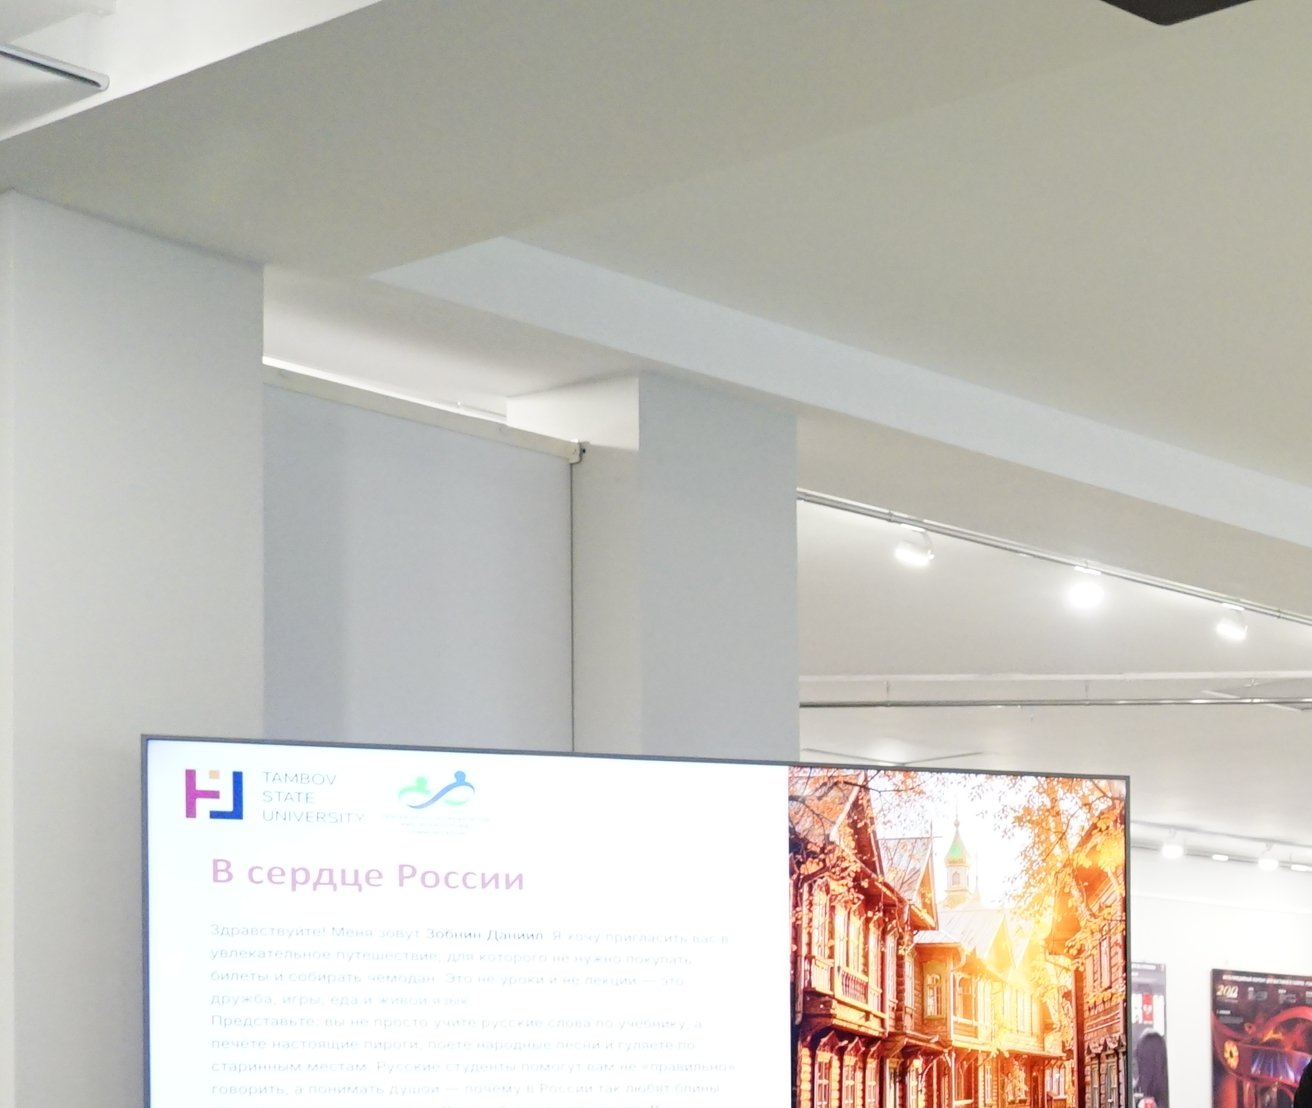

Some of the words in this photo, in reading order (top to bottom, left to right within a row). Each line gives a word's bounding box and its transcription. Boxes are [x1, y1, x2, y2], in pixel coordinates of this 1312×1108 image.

[262, 770, 337, 786] TAMBOV
[262, 788, 315, 804] STATE
[262, 808, 365, 825] UNIVERSITY
[211, 858, 234, 885] В
[247, 863, 384, 893] сердце
[397, 864, 525, 891] России
